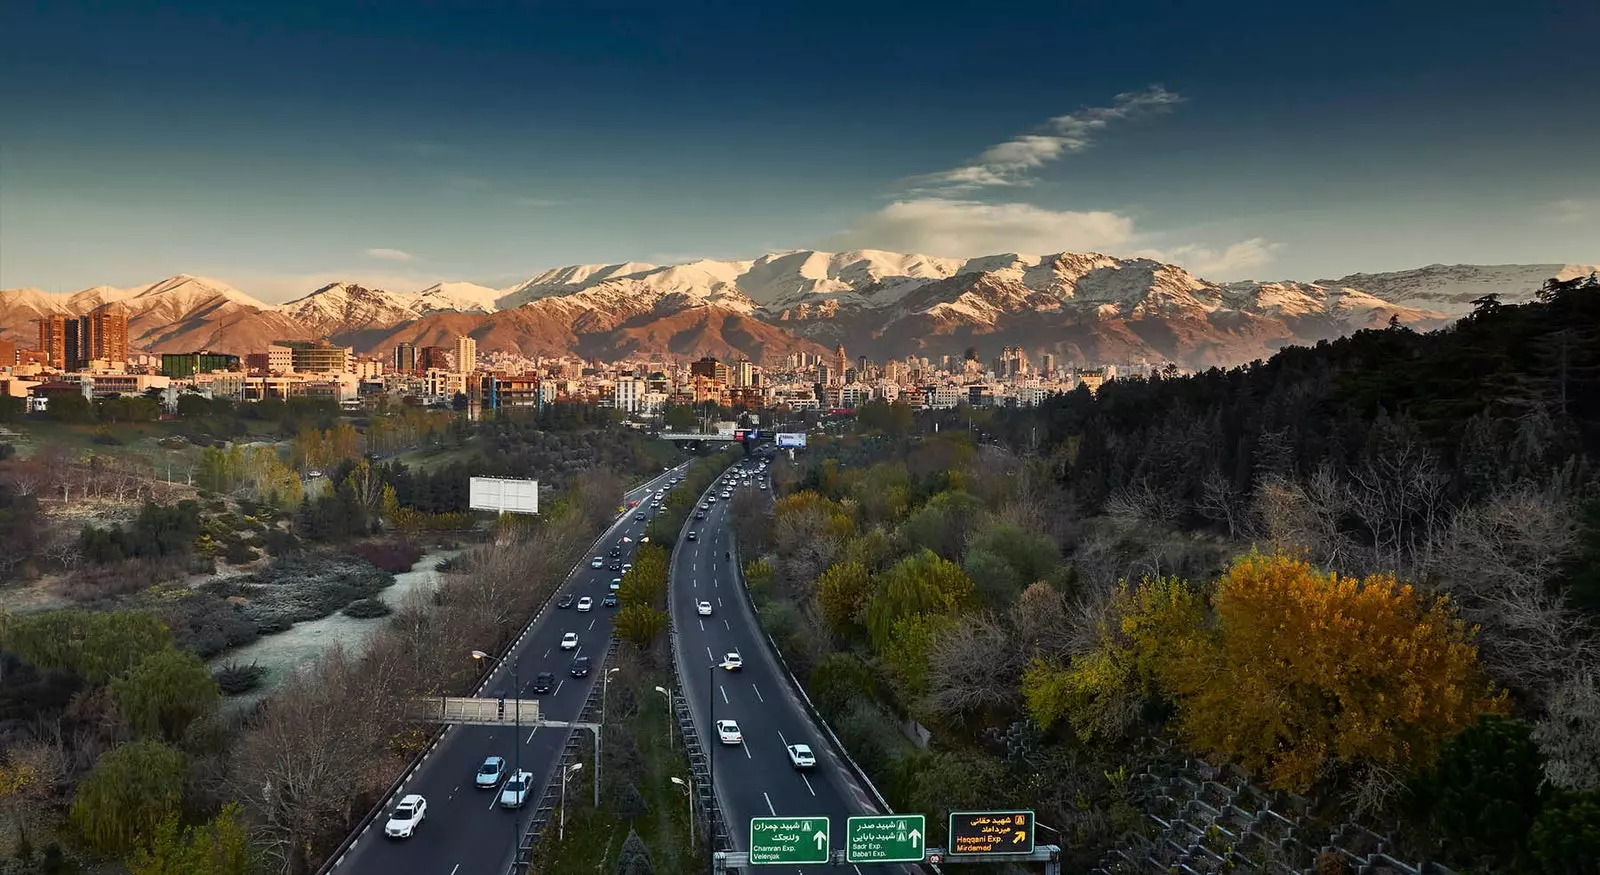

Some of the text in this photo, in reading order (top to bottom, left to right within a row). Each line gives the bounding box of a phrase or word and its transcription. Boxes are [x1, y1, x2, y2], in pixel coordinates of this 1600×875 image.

[970, 816, 1012, 826] شهید حقانی
[754, 821, 800, 832] شهید چمران
[856, 820, 896, 832] شهید صدر
[981, 826, 1011, 834] میرداماد
[852, 832, 896, 843] شهید بابایی
[956, 835, 1003, 844] Haqqani Exp.
[782, 845, 796, 853] Exp.
[956, 844, 992, 852] Mirdamad
[753, 853, 780, 861] Velenjak
[872, 850, 887, 858] Exp.
